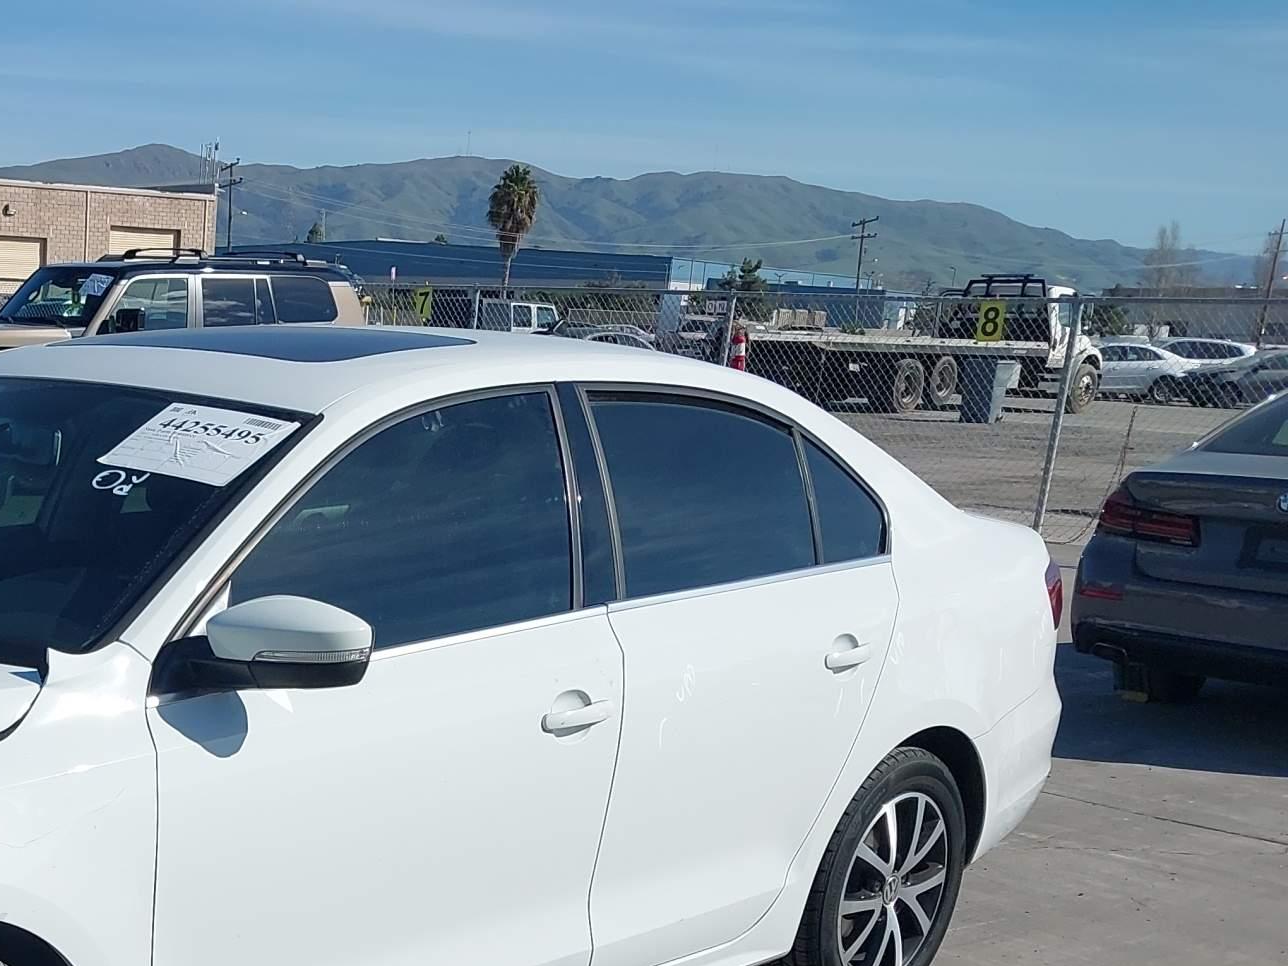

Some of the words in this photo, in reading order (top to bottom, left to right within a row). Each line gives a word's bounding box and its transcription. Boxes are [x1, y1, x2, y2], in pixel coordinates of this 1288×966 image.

[419, 291, 430, 315] 7
[981, 306, 1000, 337] 8
[159, 418, 264, 444] 44255495
